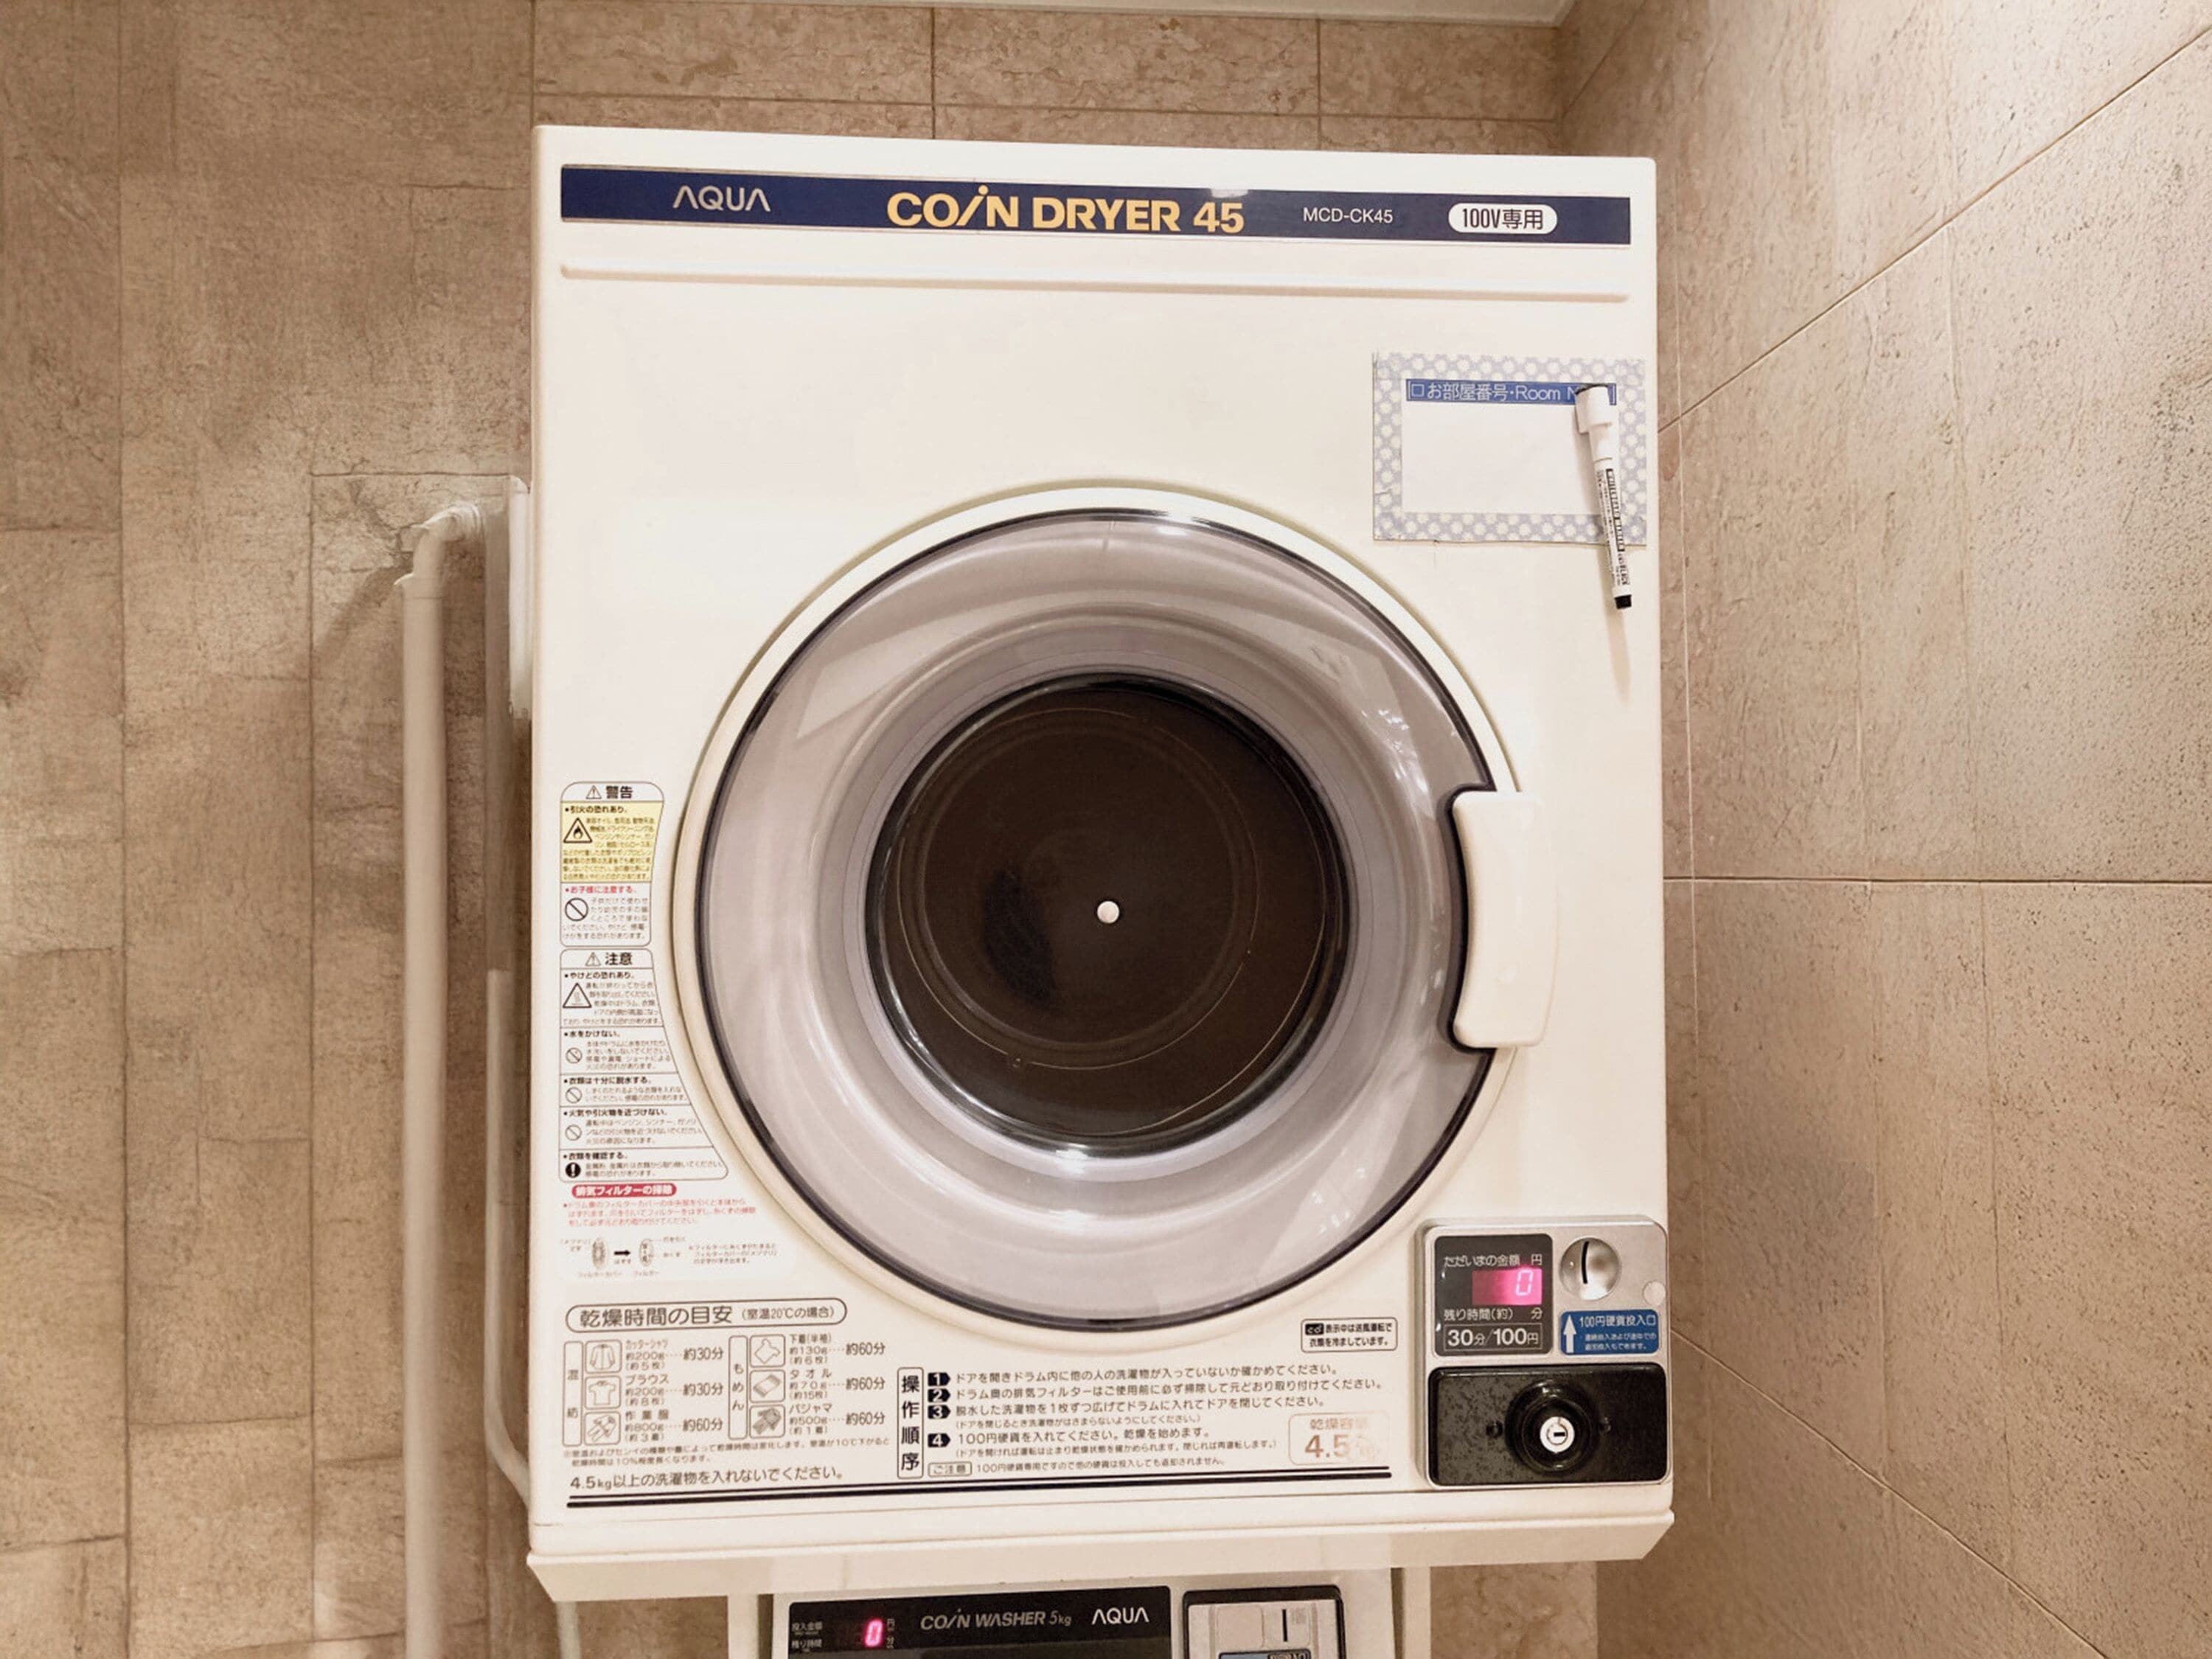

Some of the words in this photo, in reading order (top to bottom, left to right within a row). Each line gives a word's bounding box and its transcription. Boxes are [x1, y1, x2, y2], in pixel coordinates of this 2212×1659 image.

[673, 185, 771, 212] AQUA
[1033, 197, 1180, 232] DRYER
[1193, 202, 1245, 233] 45
[1302, 207, 1394, 224] MCD-CK45
[1462, 207, 1544, 231] 100V専用
[605, 785, 633, 799] 警告
[605, 952, 633, 967] 注意
[575, 1183, 673, 1197] 排気フィルターの掃除
[1444, 1254, 1520, 1267] ただいまの金額
[1531, 1253, 1543, 1265] 円
[1516, 1269, 1534, 1296] 0
[580, 1305, 733, 1328] 乾燥時間の目安
[1444, 1307, 1514, 1321] 残り時間(約)
[1531, 1307, 1543, 1320] 分
[1580, 1314, 1657, 1327] 100円硬貨投入口
[1447, 1327, 1540, 1347] 30分/100円
[683, 1346, 724, 1361] 約30分
[846, 1342, 886, 1356] 約60分
[683, 1382, 724, 1397] 約30分
[846, 1377, 886, 1391] 約60分
[683, 1417, 723, 1433] 約60分
[845, 1411, 886, 1425] 約60分
[901, 1374, 920, 1472] 操作順序
[570, 1465, 844, 1490] 4.5kg以上の洗濯物を入れないでください。
[975, 1610, 1046, 1627] WASHER
[1049, 1610, 1072, 1627] 5kg
[1092, 1607, 1150, 1625] AQUA
[864, 1618, 884, 1649] 0
